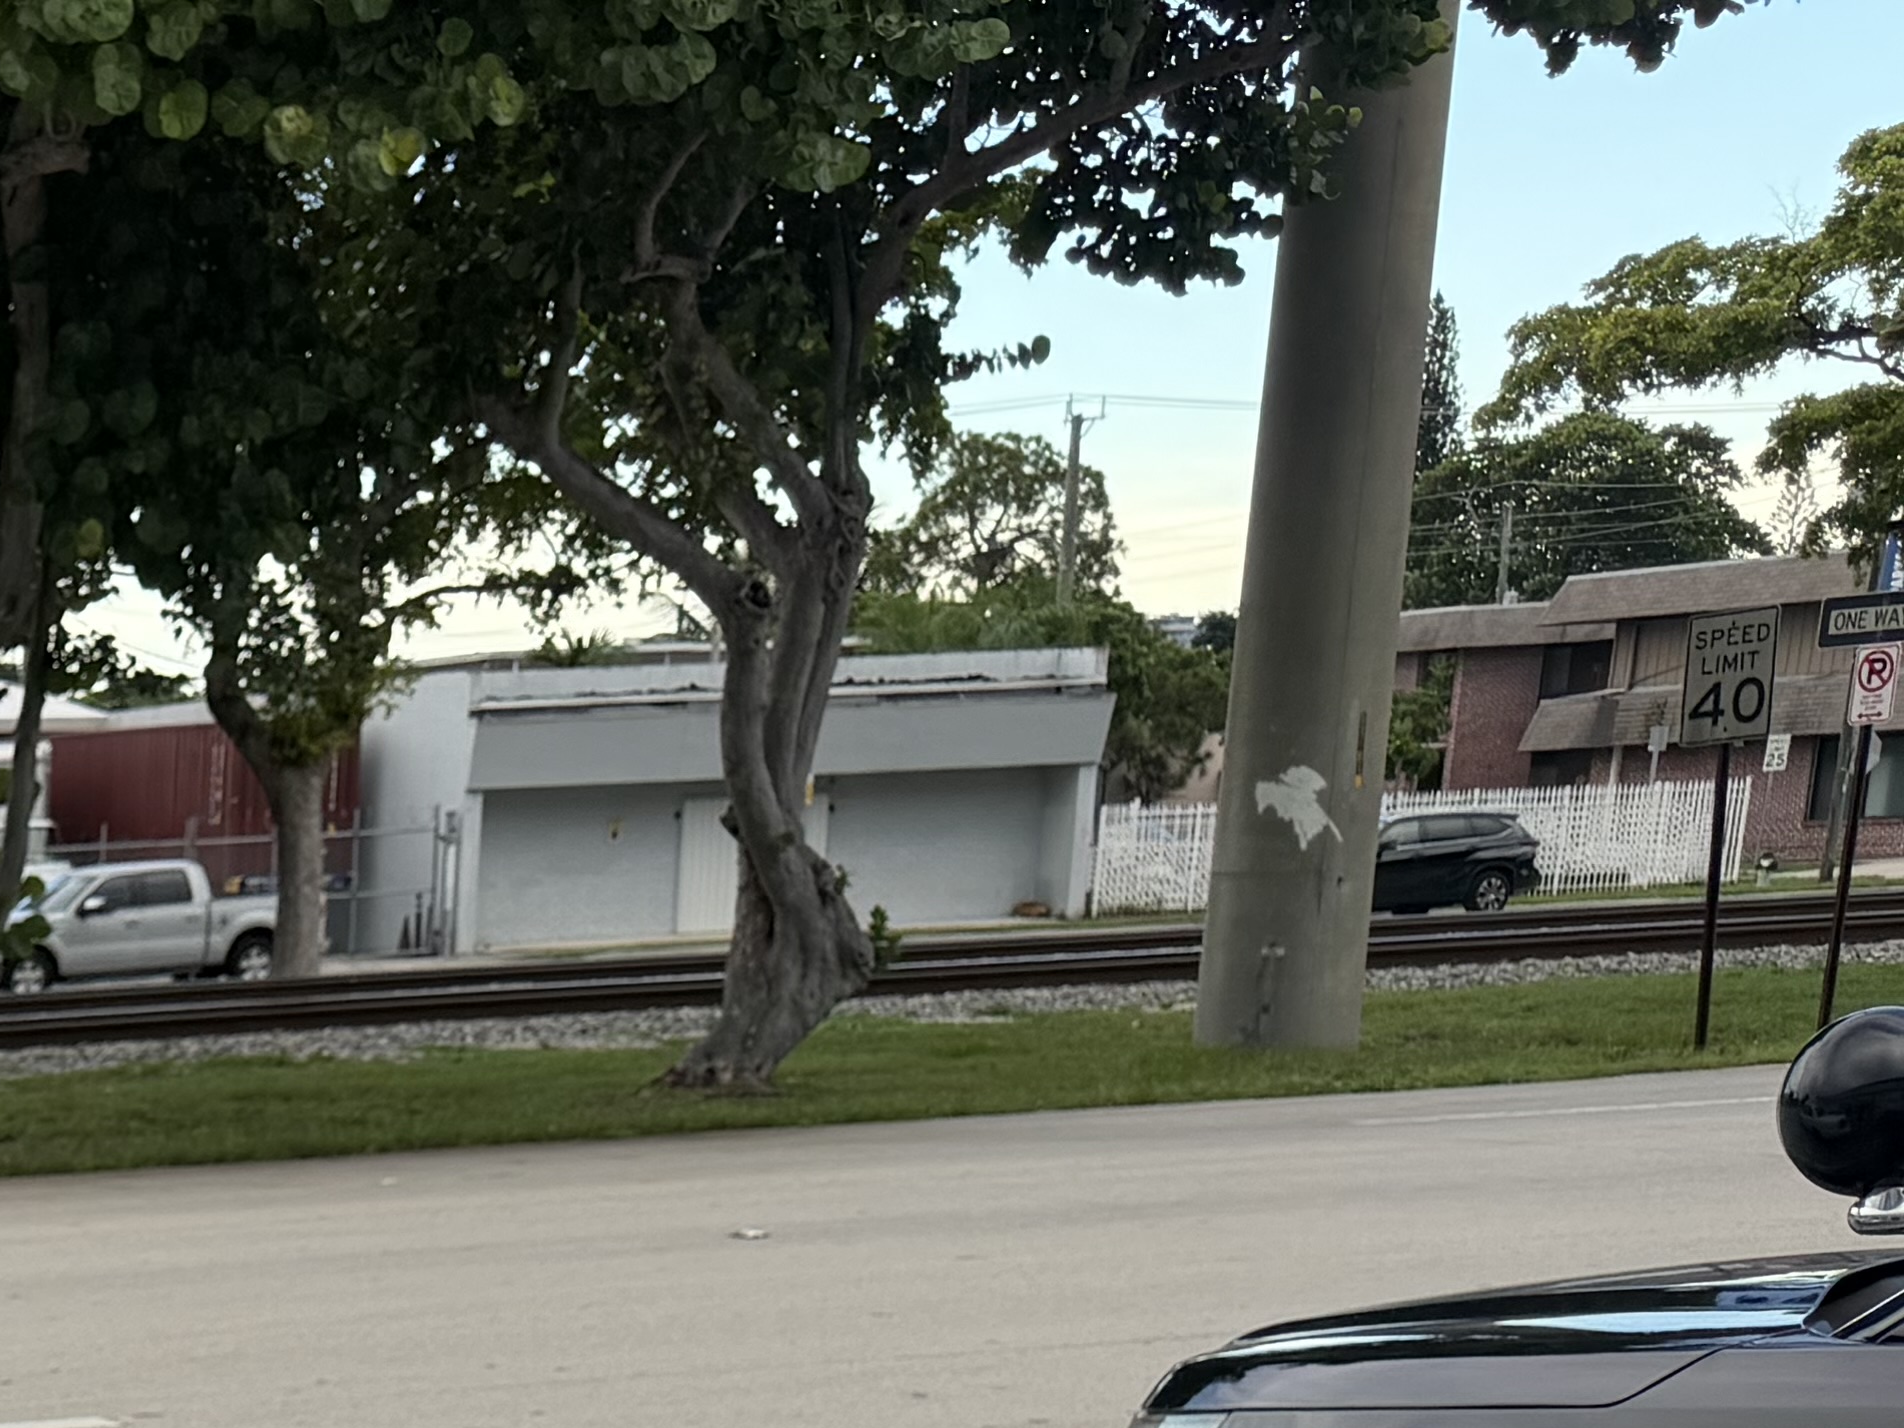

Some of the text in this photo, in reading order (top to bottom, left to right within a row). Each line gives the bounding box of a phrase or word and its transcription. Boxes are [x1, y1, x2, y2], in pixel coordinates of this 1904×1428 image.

[1834, 607, 1904, 631] ONE WA
[1695, 622, 1770, 650] SPEED
[1701, 650, 1760, 675] LIMIT
[1688, 677, 1765, 726] 40
[1765, 752, 1785, 767] 25
